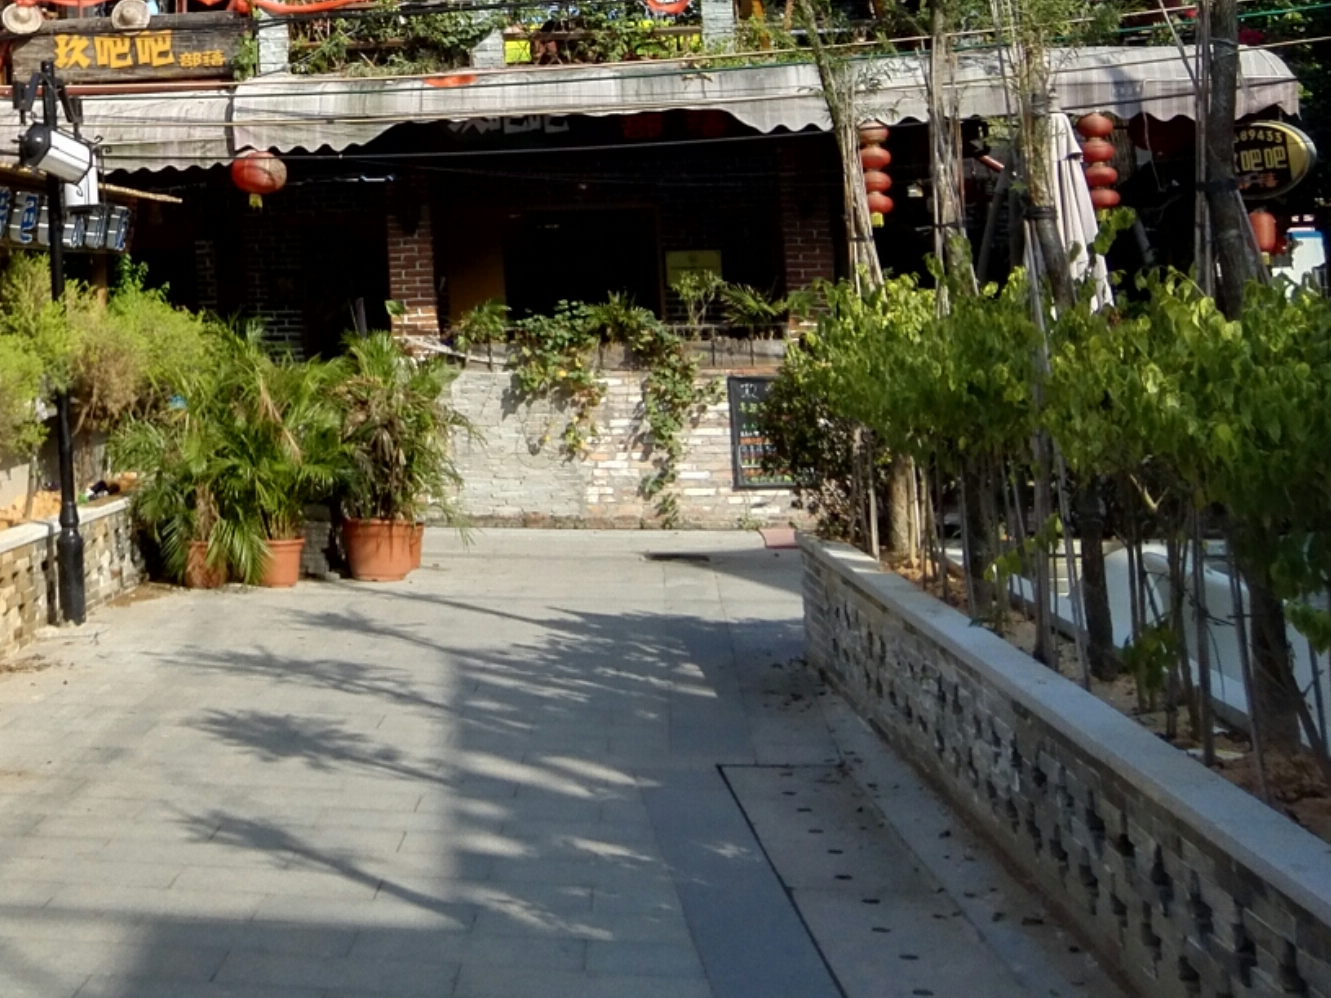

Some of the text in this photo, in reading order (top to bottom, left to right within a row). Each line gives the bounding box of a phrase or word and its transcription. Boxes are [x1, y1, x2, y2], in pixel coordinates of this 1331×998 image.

[53, 29, 226, 69] 玖吧吧 部落
[1234, 146, 1287, 173] 吧吧
